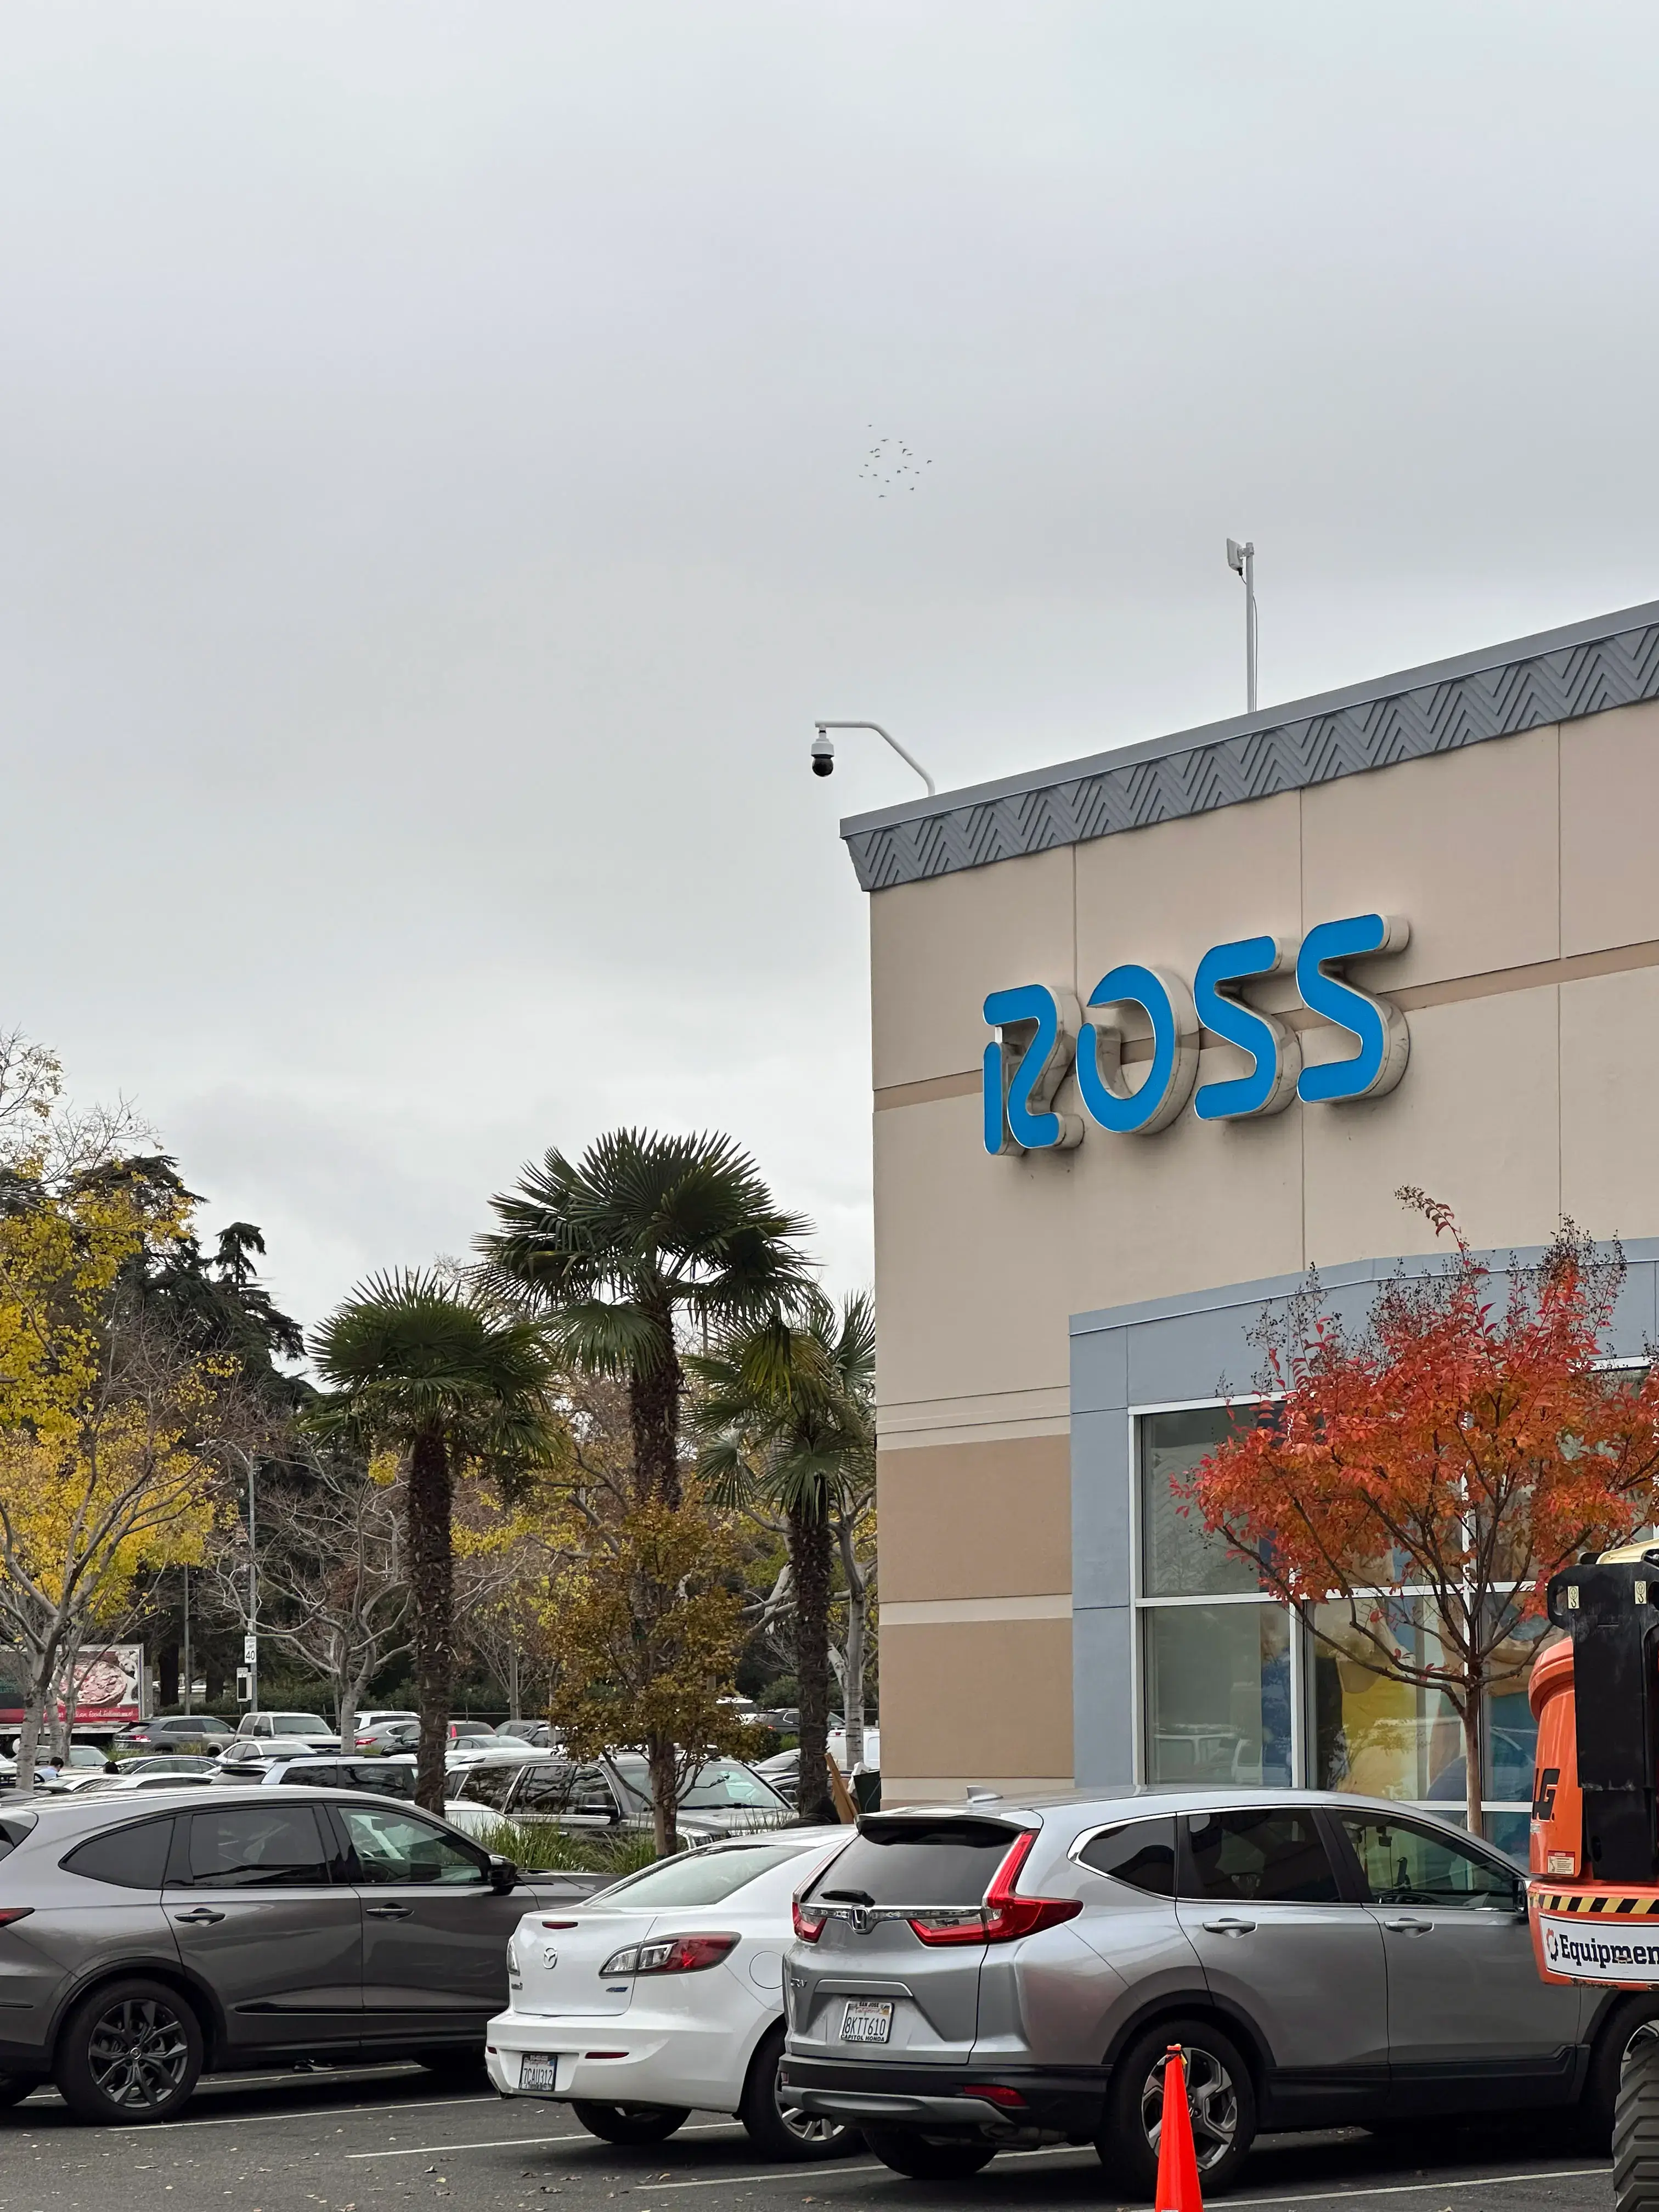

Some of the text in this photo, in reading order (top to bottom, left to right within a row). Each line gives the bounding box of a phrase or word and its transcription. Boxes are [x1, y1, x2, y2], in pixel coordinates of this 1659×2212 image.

[983, 913, 1388, 1155] ROSS
[246, 1650, 255, 1660] 40
[845, 2017, 886, 2036] 8KTT610
[524, 2068, 553, 2085] 7CAU312
